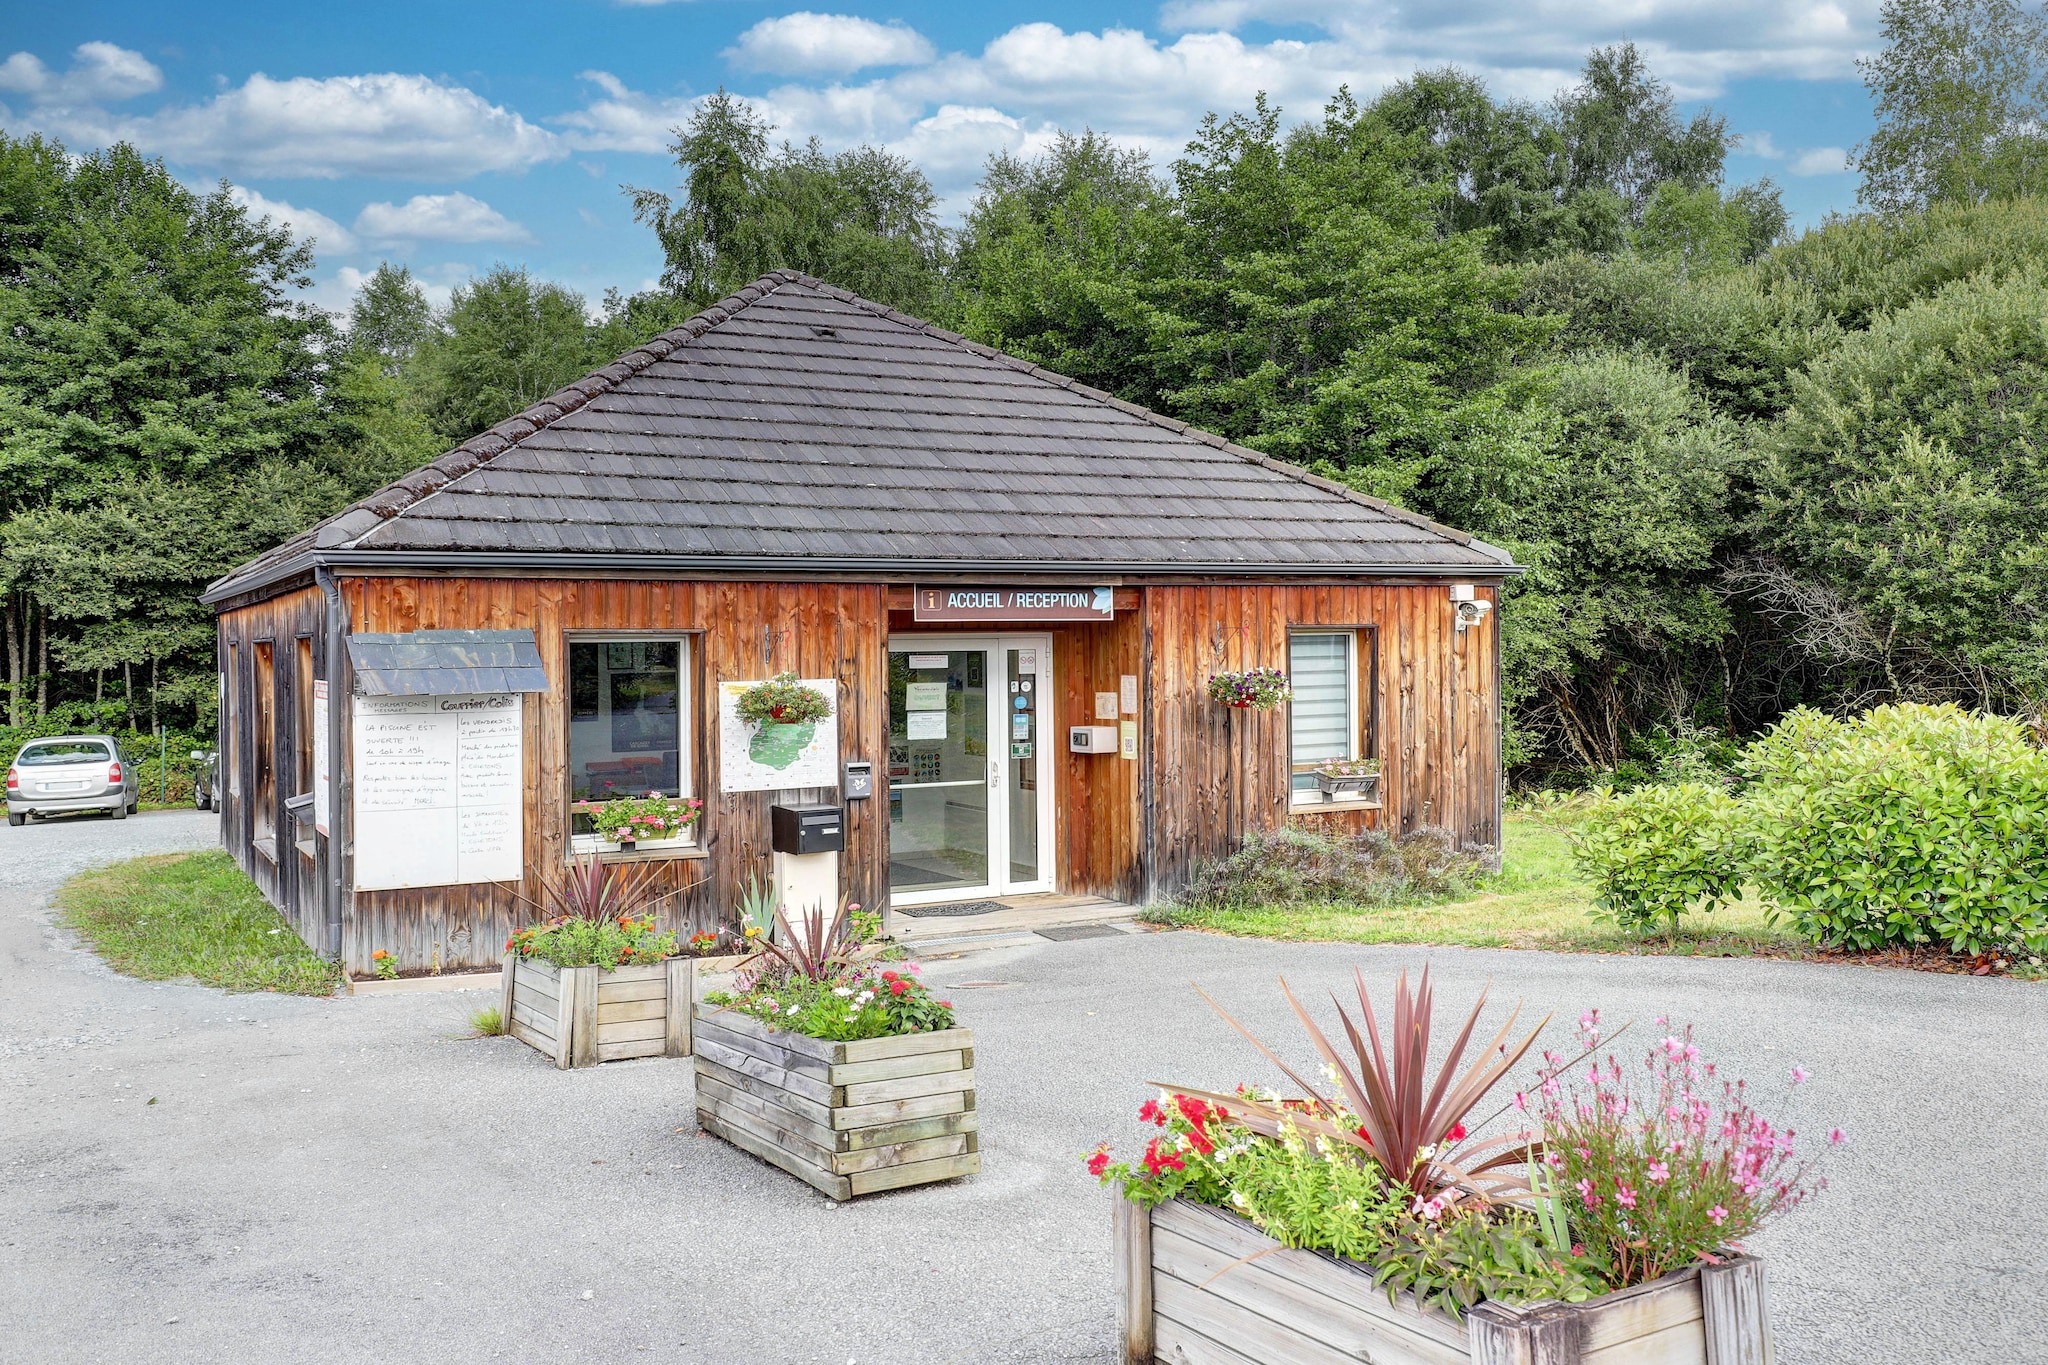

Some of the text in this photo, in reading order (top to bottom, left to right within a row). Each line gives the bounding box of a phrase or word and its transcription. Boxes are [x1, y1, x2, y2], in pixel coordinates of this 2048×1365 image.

[947, 592, 1004, 608] ACCUEIL
[1016, 592, 1089, 608] RECEPTION
[362, 700, 428, 709] INFORMATIONS
[380, 724, 414, 732] PISCINE
[418, 724, 437, 732] EST
